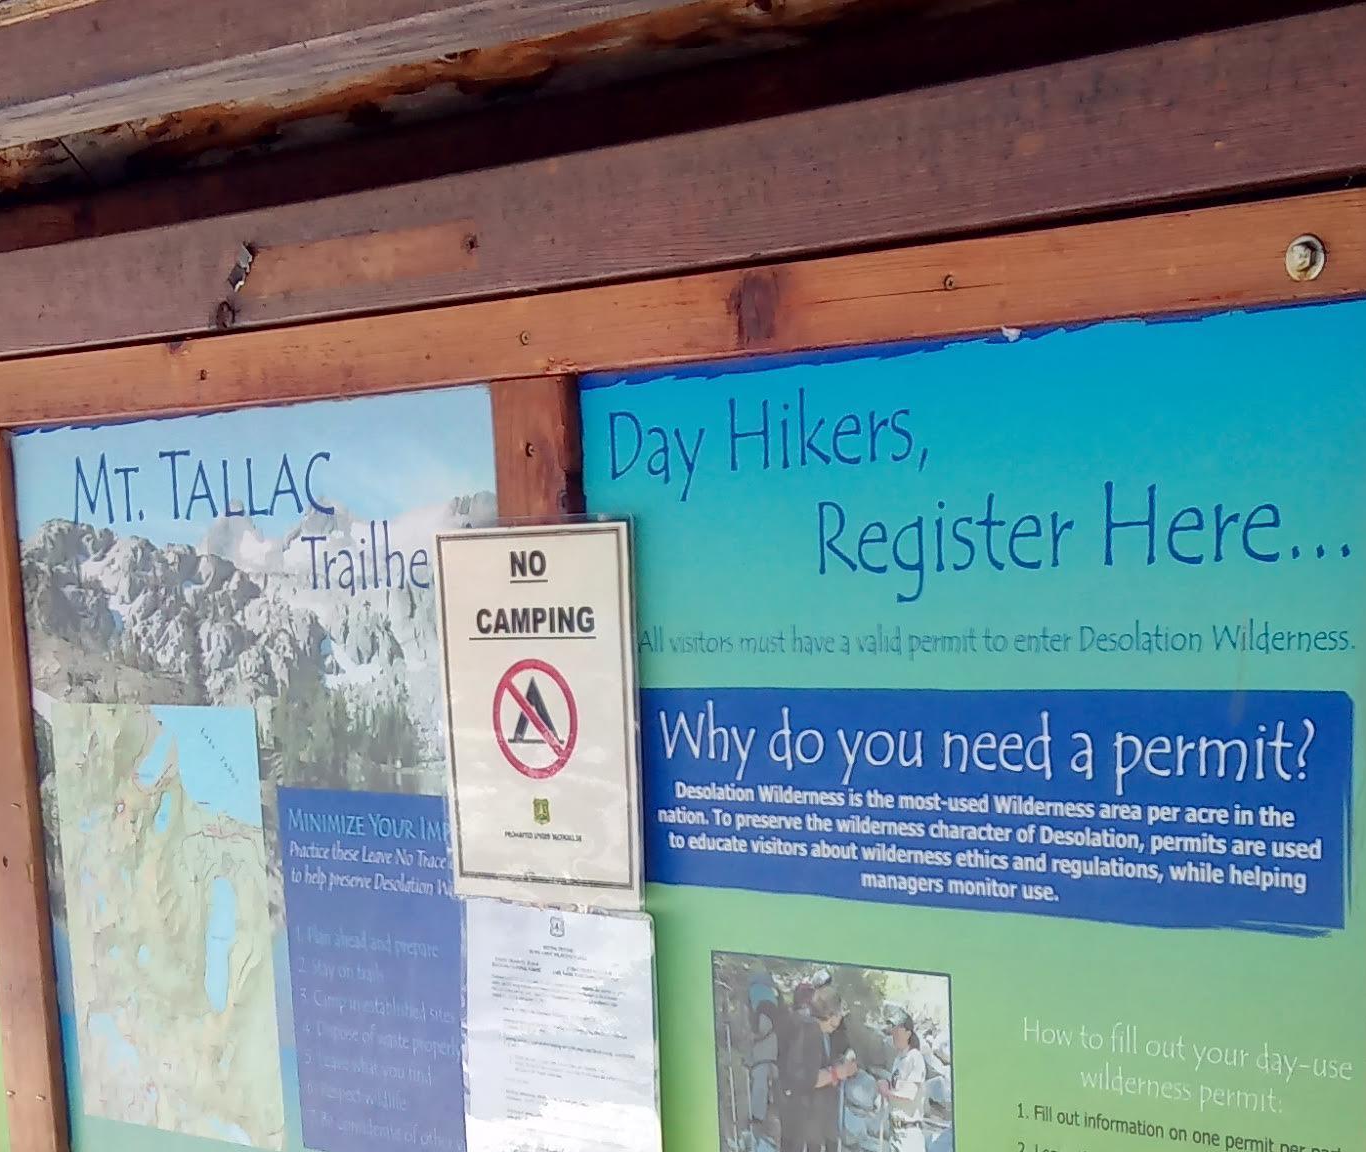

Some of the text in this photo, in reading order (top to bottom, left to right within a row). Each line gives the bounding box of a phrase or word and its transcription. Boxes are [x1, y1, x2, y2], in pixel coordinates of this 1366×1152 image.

[608, 389, 928, 501] Day Hikers,
[300, 519, 431, 597] Trailhe
[509, 550, 546, 577] NO
[818, 481, 1350, 603] Register Here...
[476, 606, 595, 635] CAMPING
[638, 618, 1356, 661] All visitors must have a valid permit to enter Desolation Wilderness.
[660, 700, 1314, 796] Why do you need a permit?
[675, 781, 1295, 828] Desolation Wilderness is the most-used Wilderness area per acre in the
[861, 873, 1059, 902] managers monitor use.
[1018, 1102, 1029, 1119] 1.
[1034, 1104, 1052, 1123] Fill
[1057, 1110, 1080, 1127] out
[1084, 1111, 1164, 1139] information
[1169, 1127, 1187, 1142] on
[1193, 1130, 1220, 1147] one
